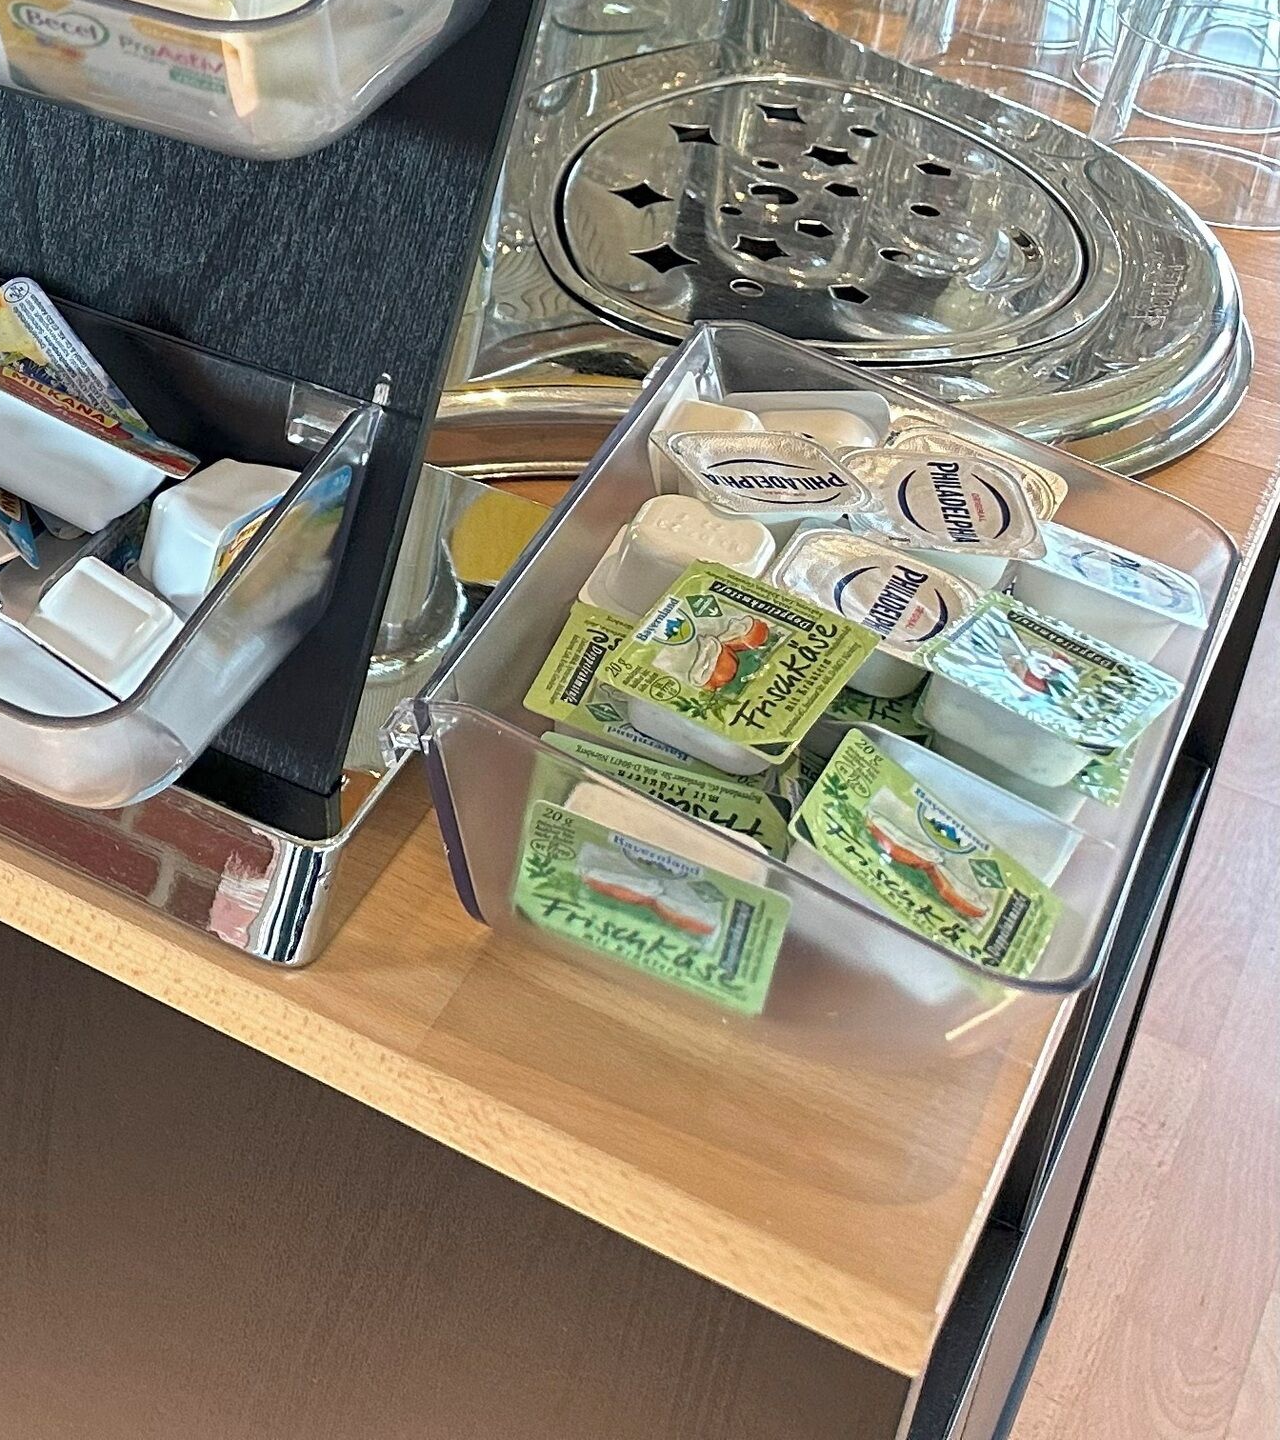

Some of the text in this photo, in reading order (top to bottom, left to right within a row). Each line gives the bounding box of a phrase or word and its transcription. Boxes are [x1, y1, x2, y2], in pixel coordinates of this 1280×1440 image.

[23, 11, 101, 44] Becel
[116, 32, 225, 75] ProActiv
[12, 371, 107, 424] MILKANA
[702, 470, 849, 491] PHILADELPHIA
[928, 461, 981, 544] PHILADELPHIA
[636, 596, 680, 642] Bayernland
[711, 582, 815, 631] Doppelrahmstufe
[1008, 611, 1116, 670] Doppelrahmstufe
[562, 643, 604, 704] Doppelrahmstufe
[605, 655, 633, 680] 20 g
[728, 623, 839, 731] Frischkäse
[855, 738, 884, 766] 20 g
[616, 769, 720, 805] mit Kräutern
[542, 807, 563, 822] 20
[915, 787, 990, 851] Bayernland
[612, 834, 701, 876] Bayernland
[822, 808, 1000, 967] Frischkäse
[533, 893, 743, 991] Frischkäse
